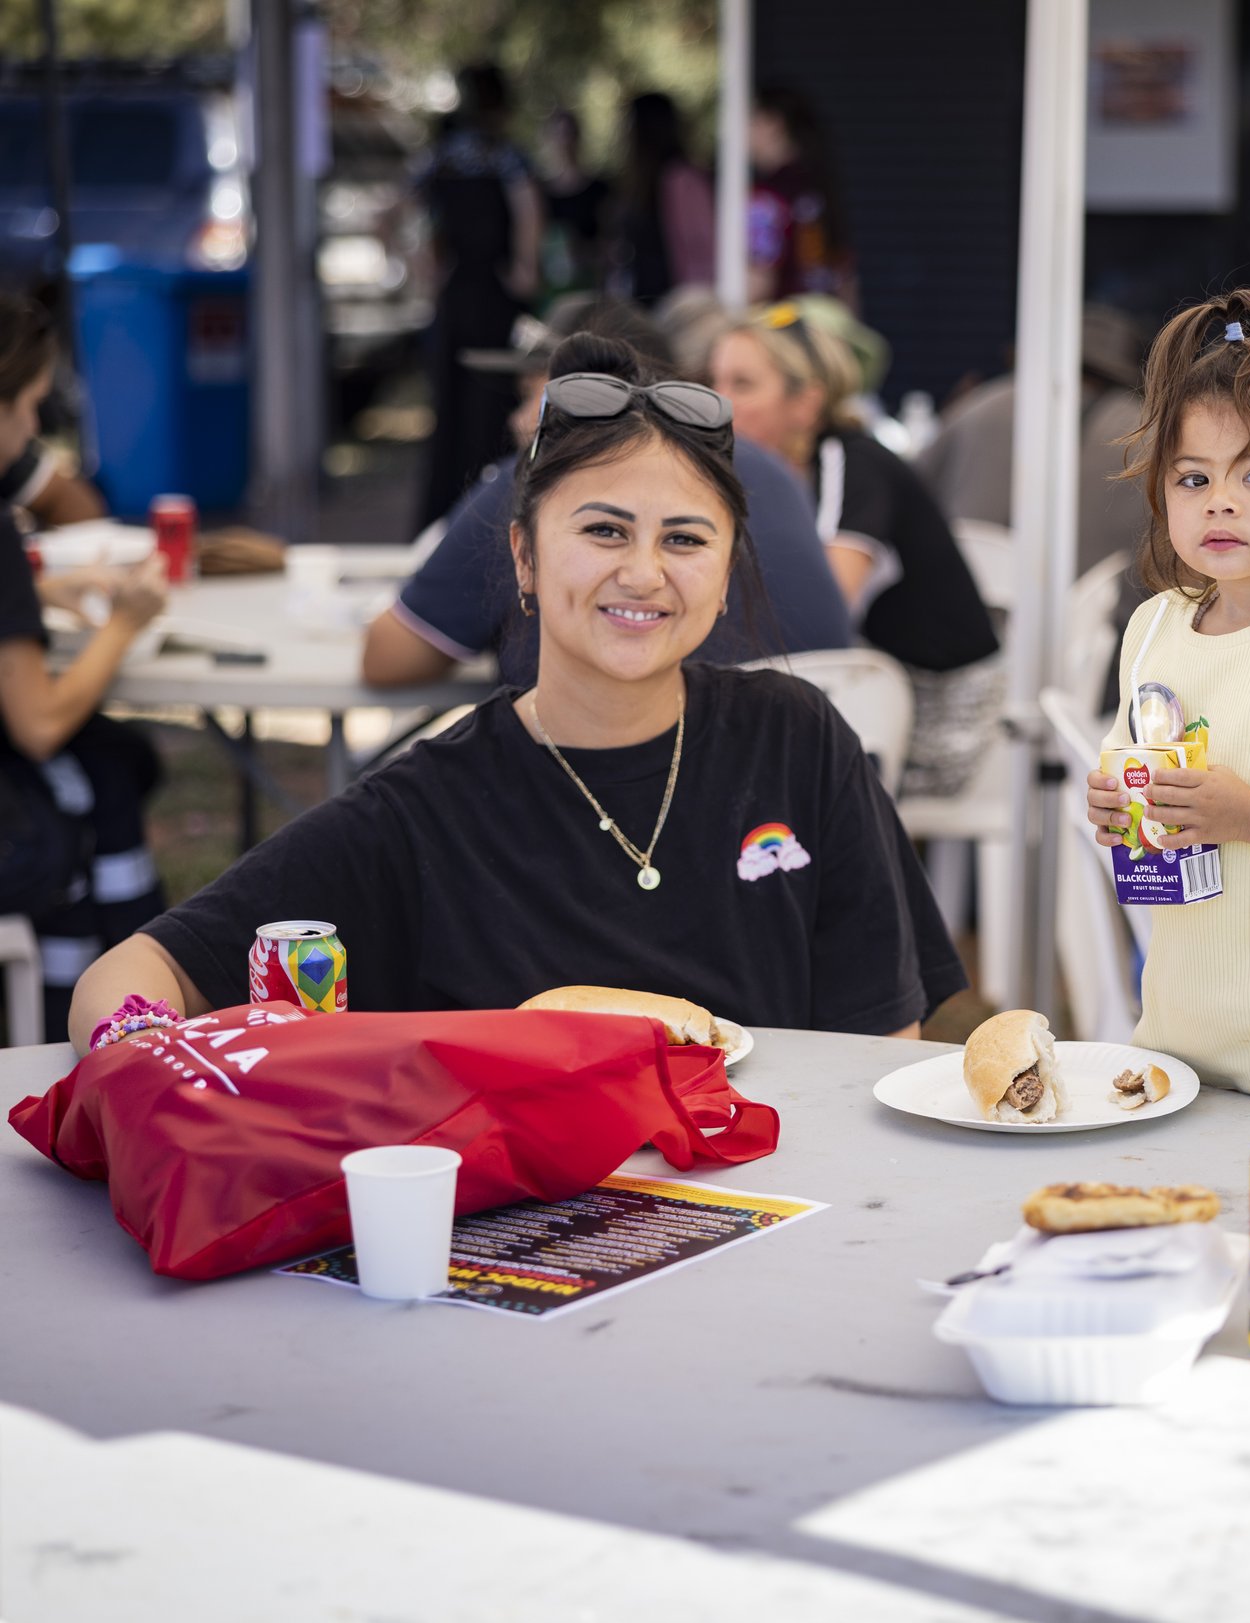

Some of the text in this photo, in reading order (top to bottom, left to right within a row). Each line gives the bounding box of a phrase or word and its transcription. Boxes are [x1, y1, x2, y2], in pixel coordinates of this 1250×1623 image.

[1126, 770, 1148, 780] golden
[1129, 777, 1147, 785] circle
[1133, 865, 1158, 873] APPLE
[1117, 874, 1179, 883] BLACKCURRANT
